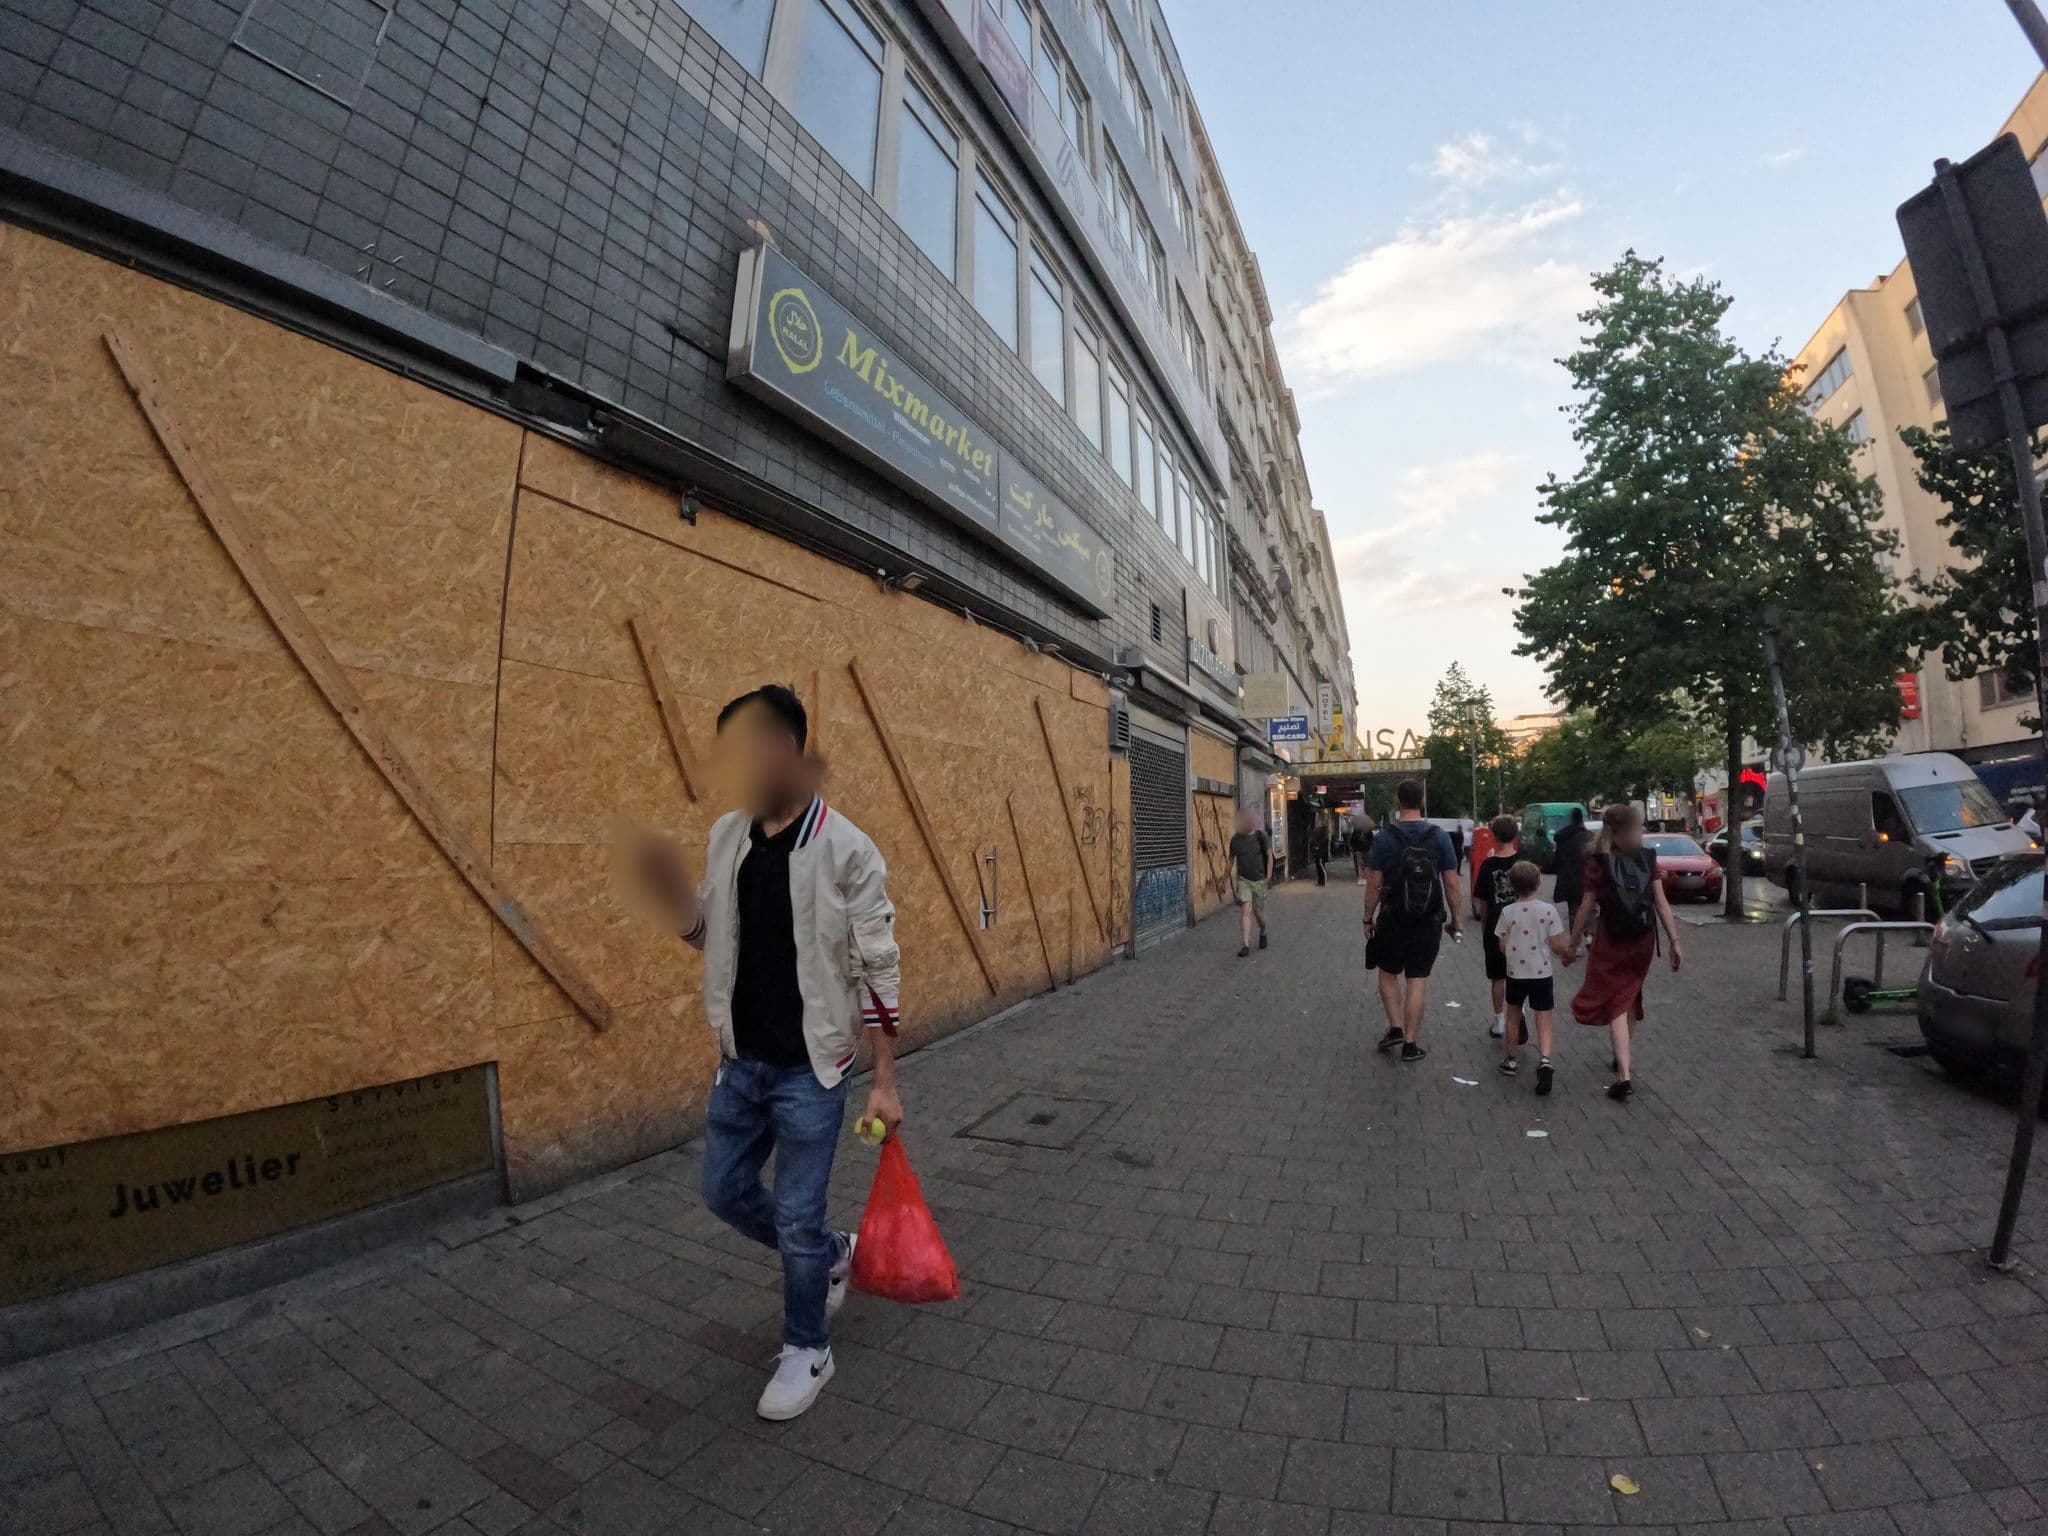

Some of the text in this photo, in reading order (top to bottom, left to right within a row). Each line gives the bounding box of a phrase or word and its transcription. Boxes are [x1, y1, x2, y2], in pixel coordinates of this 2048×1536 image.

[781, 326, 809, 352] HALAL
[837, 328, 993, 477] Mixmarket
[1321, 693, 1330, 720] HOTEL
[109, 1150, 302, 1219] Juwelier
